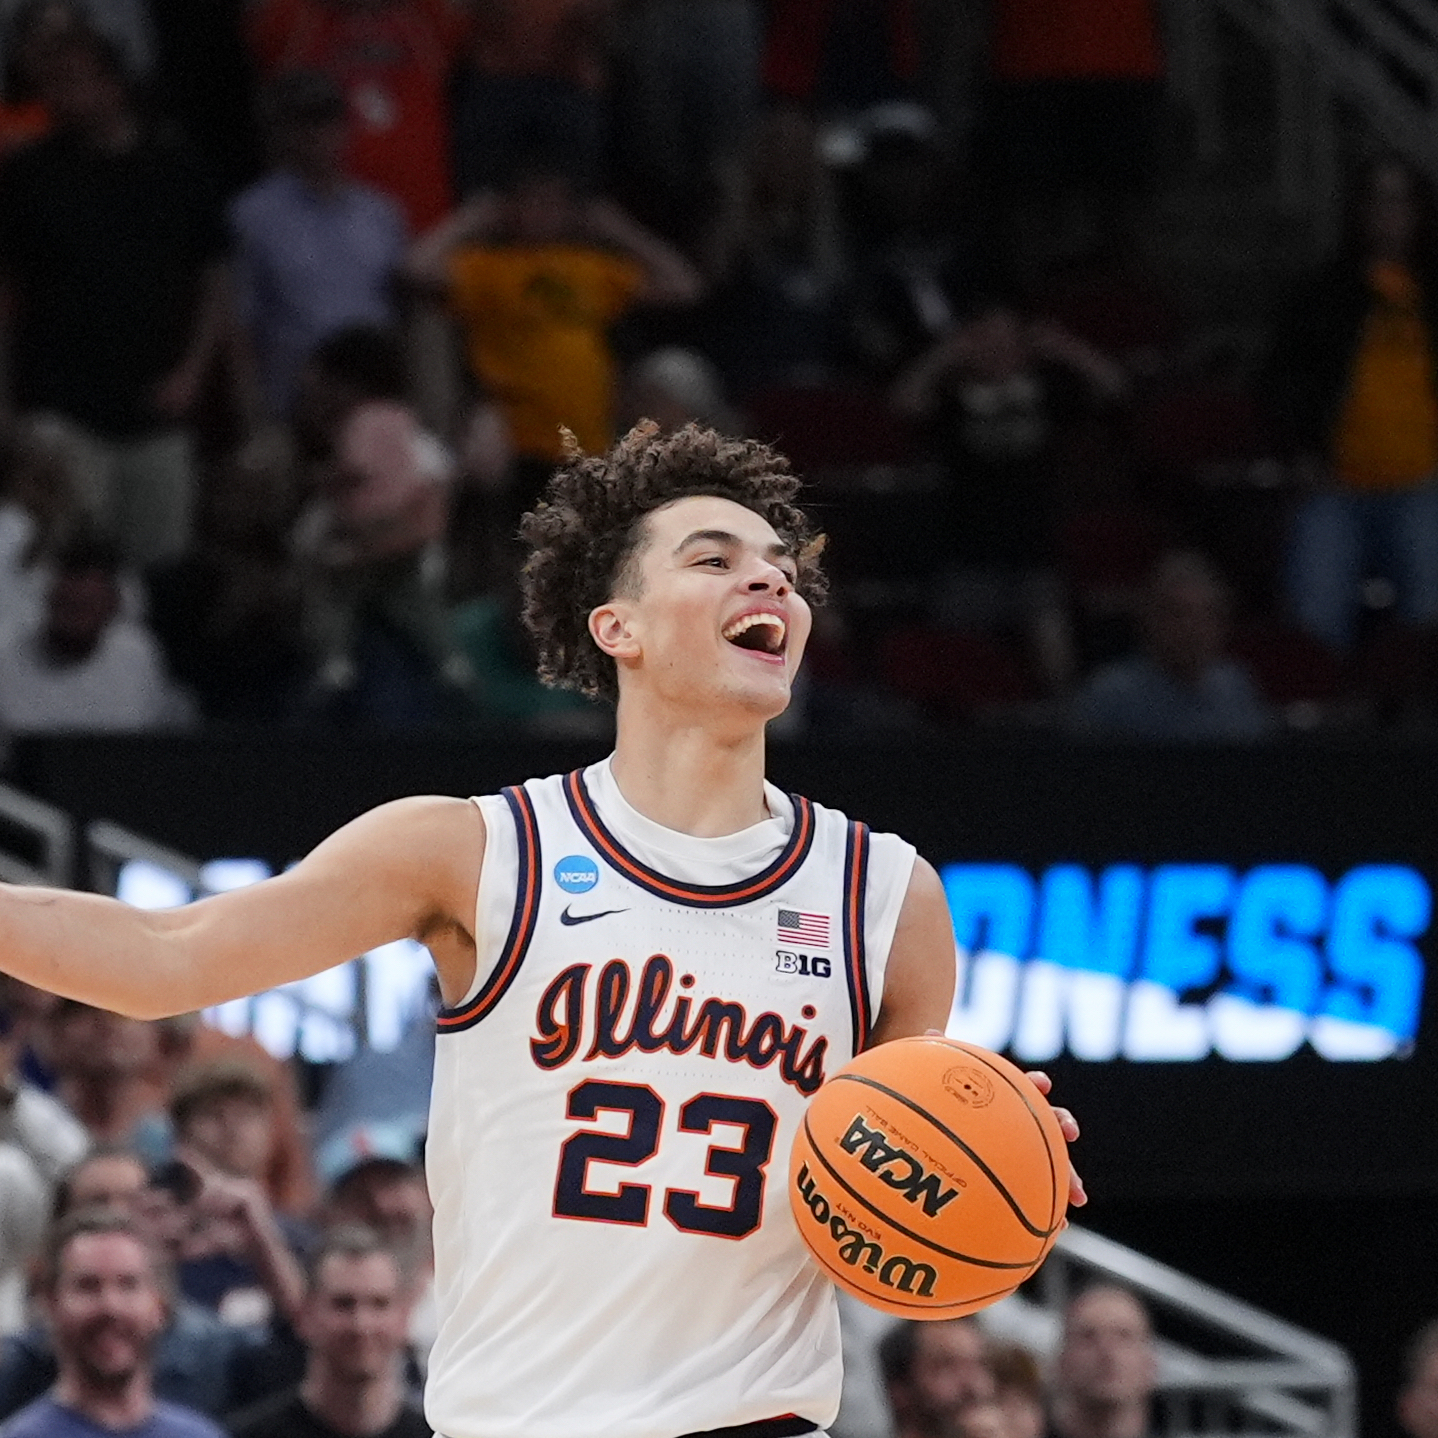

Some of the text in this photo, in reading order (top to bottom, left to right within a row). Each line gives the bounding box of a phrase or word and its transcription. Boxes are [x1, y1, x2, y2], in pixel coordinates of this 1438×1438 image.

[559, 871, 597, 884] NCAA
[530, 953, 829, 1098] Illinois
[942, 862, 1433, 1063] DNESS
[552, 1077, 779, 1241] 23
[796, 1160, 938, 1298] Wilson
[839, 1112, 960, 1218] NCAA
